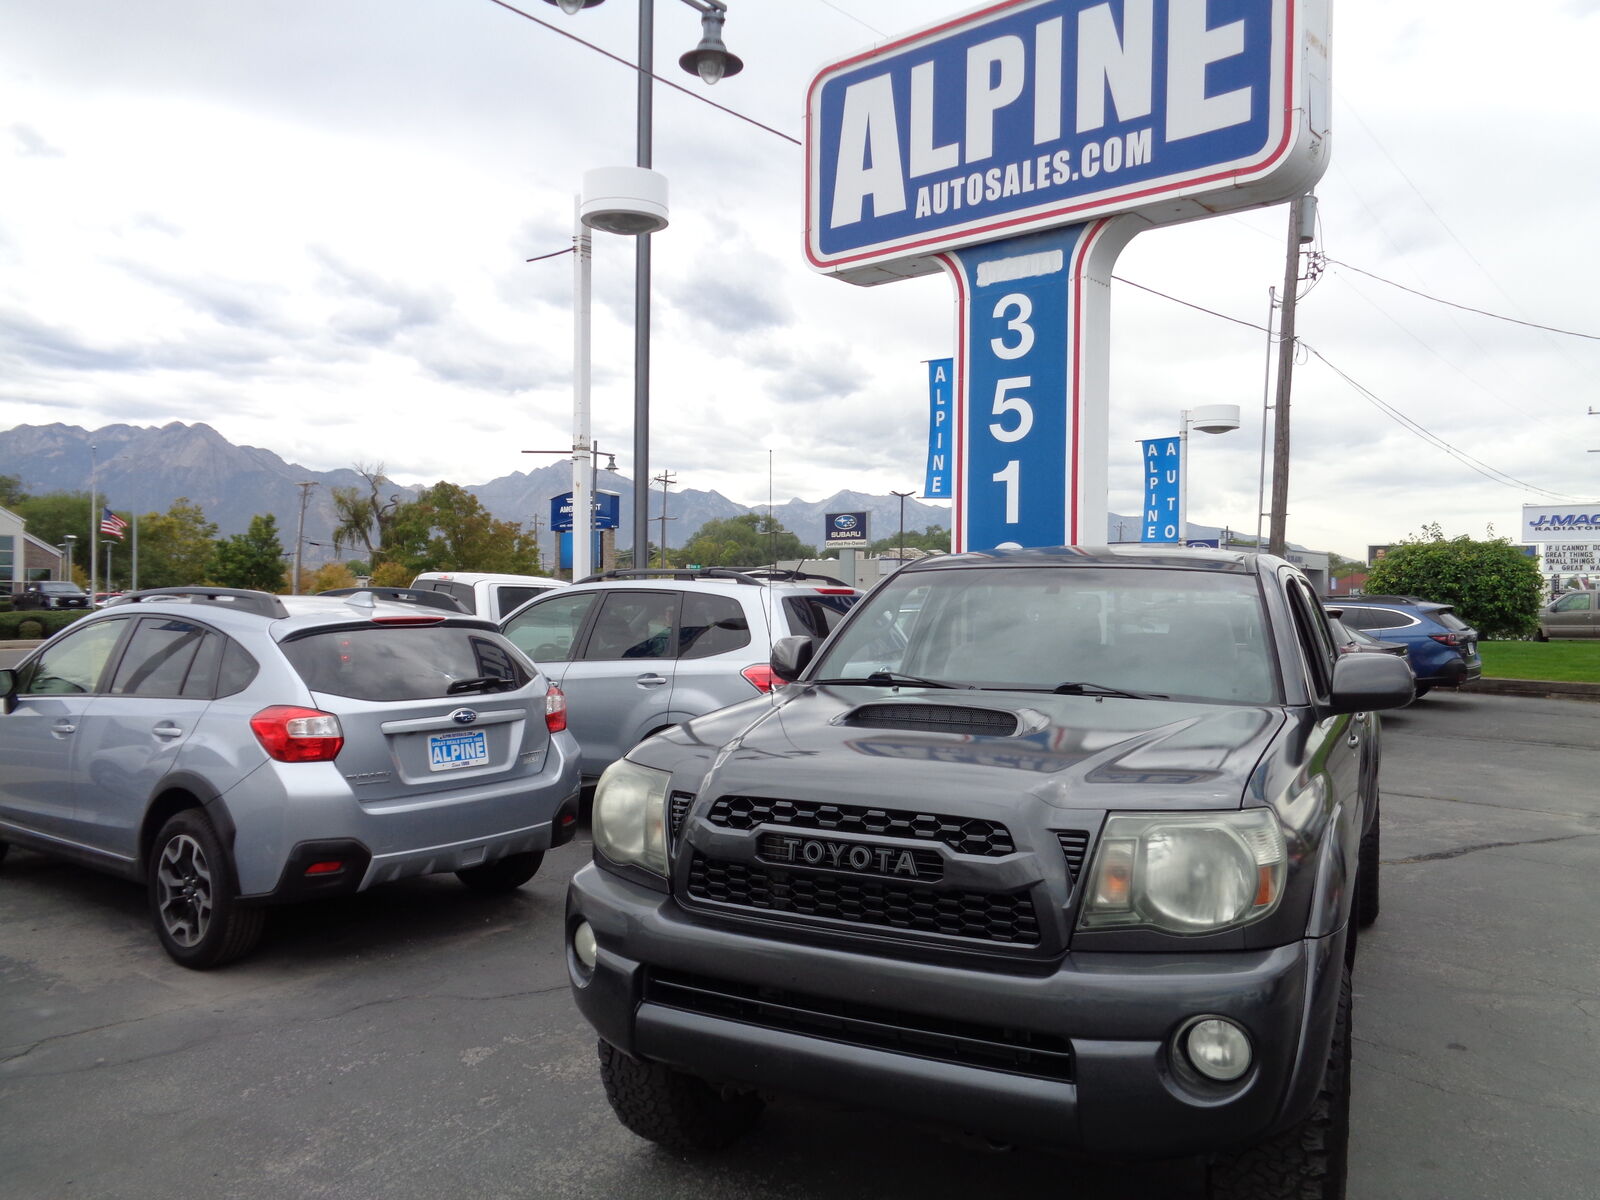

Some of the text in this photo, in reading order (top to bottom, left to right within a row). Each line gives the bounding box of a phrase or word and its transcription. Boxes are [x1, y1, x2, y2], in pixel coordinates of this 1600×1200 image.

[831, 0, 1252, 229] ALPINE
[915, 128, 1152, 219] AUTOSALES.COM
[931, 366, 946, 493] ALPINE
[989, 293, 1035, 549] 351
[1147, 444, 1159, 539] ALPINE
[1164, 442, 1176, 539] AUTO
[432, 741, 486, 764] ALPINE
[783, 837, 919, 877] TOYOTA
